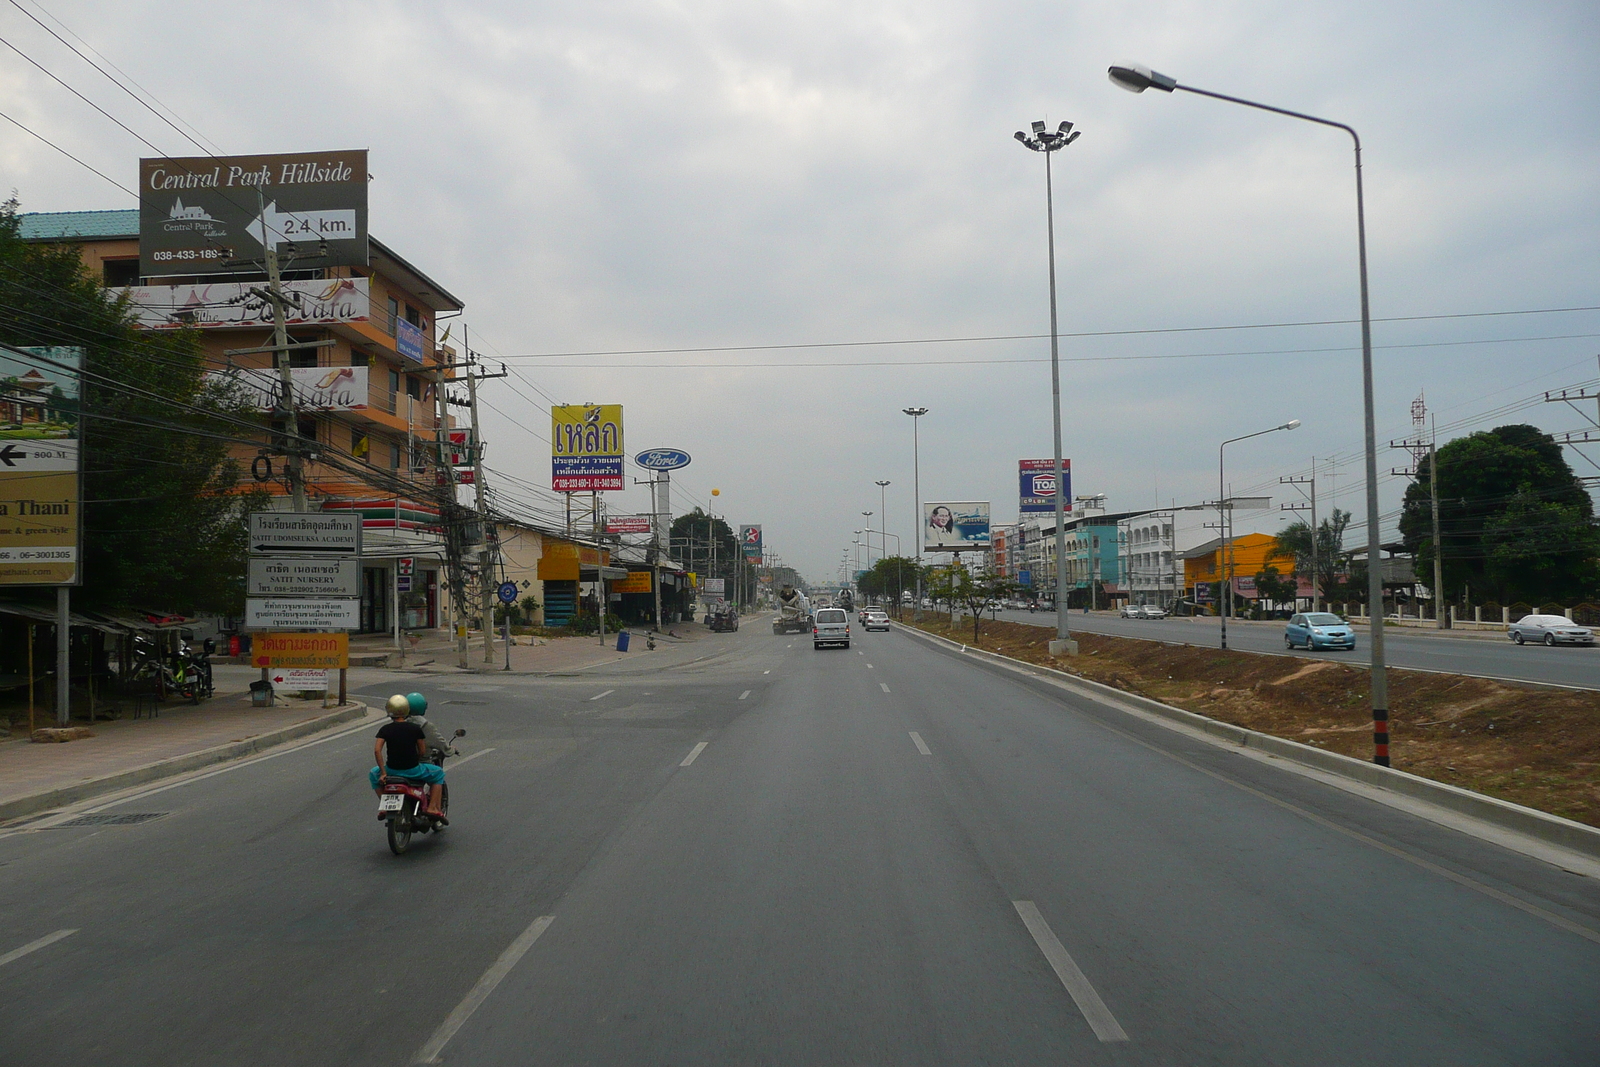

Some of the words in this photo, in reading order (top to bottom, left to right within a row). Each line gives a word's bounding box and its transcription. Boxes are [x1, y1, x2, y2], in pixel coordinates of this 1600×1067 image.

[151, 167, 219, 190] Central
[226, 165, 271, 187] Park
[279, 161, 352, 184] Hillside
[164, 223, 193, 232] Central
[194, 222, 214, 230] Park
[284, 219, 310, 234] 2.4
[319, 218, 352, 233] km.
[34, 451, 53, 459] 800
[56, 451, 68, 459] M.
[646, 451, 679, 466] Ford
[1034, 481, 1056, 489] TOA
[16, 499, 69, 516] Thani
[15, 527, 22, 535] &
[26, 528, 48, 536] green
[273, 535, 320, 543] UDOMSEUKSA
[20, 551, 70, 559] 06-3001305
[296, 576, 336, 584] NURSERY
